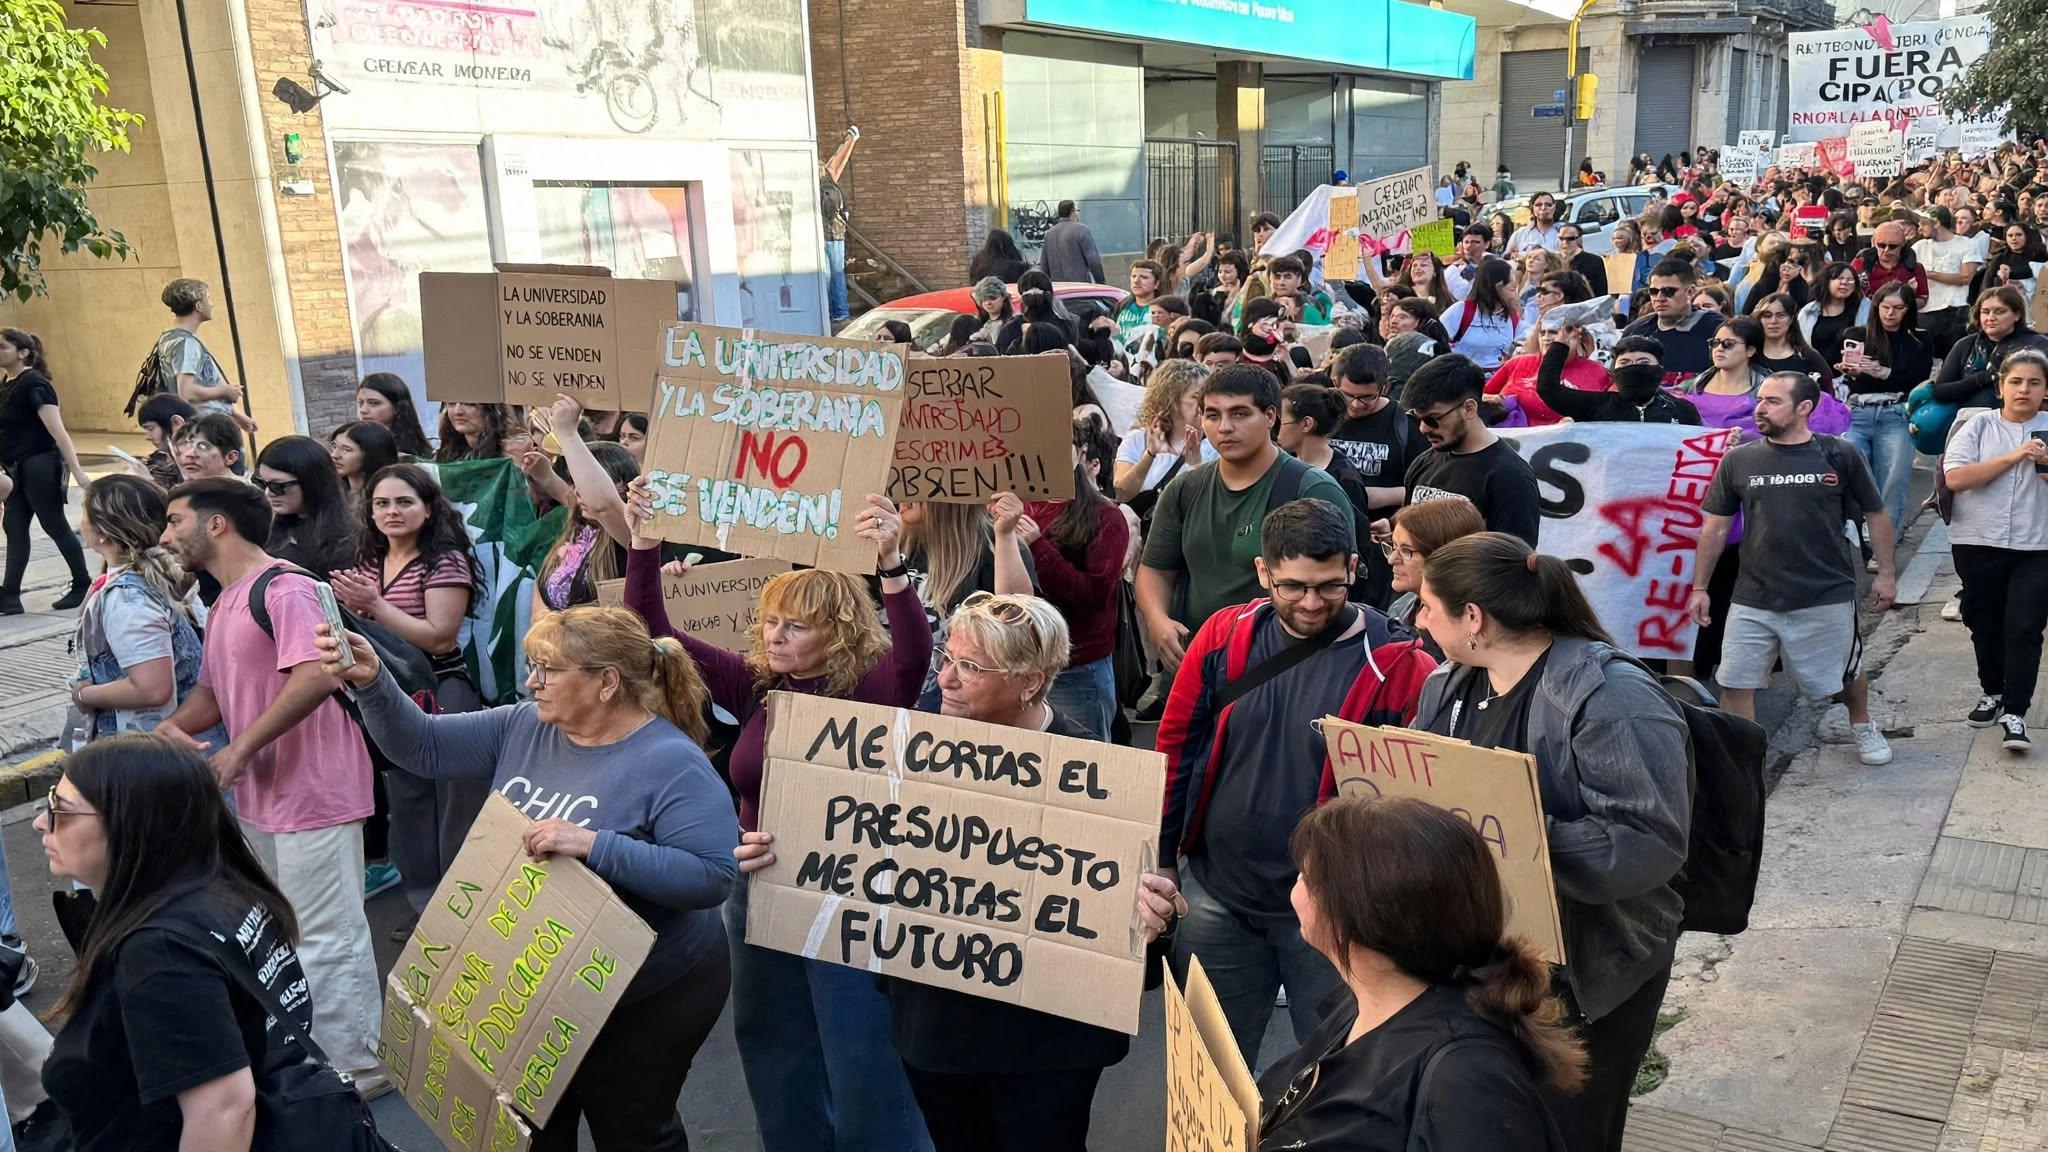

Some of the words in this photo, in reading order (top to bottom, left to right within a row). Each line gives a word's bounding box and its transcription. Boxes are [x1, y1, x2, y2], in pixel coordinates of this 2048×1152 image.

[1829, 45, 1964, 80] FUERA
[503, 286, 520, 301] LA
[523, 287, 607, 305] UNIVERSIDAD
[504, 310, 511, 325] Y
[516, 310, 532, 325] LA
[535, 311, 605, 328] SOBERANIA
[506, 344, 524, 359] NO
[529, 345, 544, 360] SE
[548, 346, 601, 363] VENDEN
[665, 327, 707, 367] LA
[508, 370, 527, 387] NO
[532, 371, 546, 388] SE
[553, 372, 605, 391] VENDEN
[735, 431, 808, 489] NO
[646, 469, 691, 516] SE
[697, 477, 842, 540] VENDEN!
[664, 583, 681, 599] LA
[805, 716, 888, 770] ME
[905, 731, 1042, 788] CORTAS
[1059, 760, 1110, 800] EL
[500, 776, 598, 827] CHIC
[825, 796, 1120, 891] PRESUPUESTO
[1034, 894, 1098, 939] EL
[841, 909, 1023, 987] FUTURO
